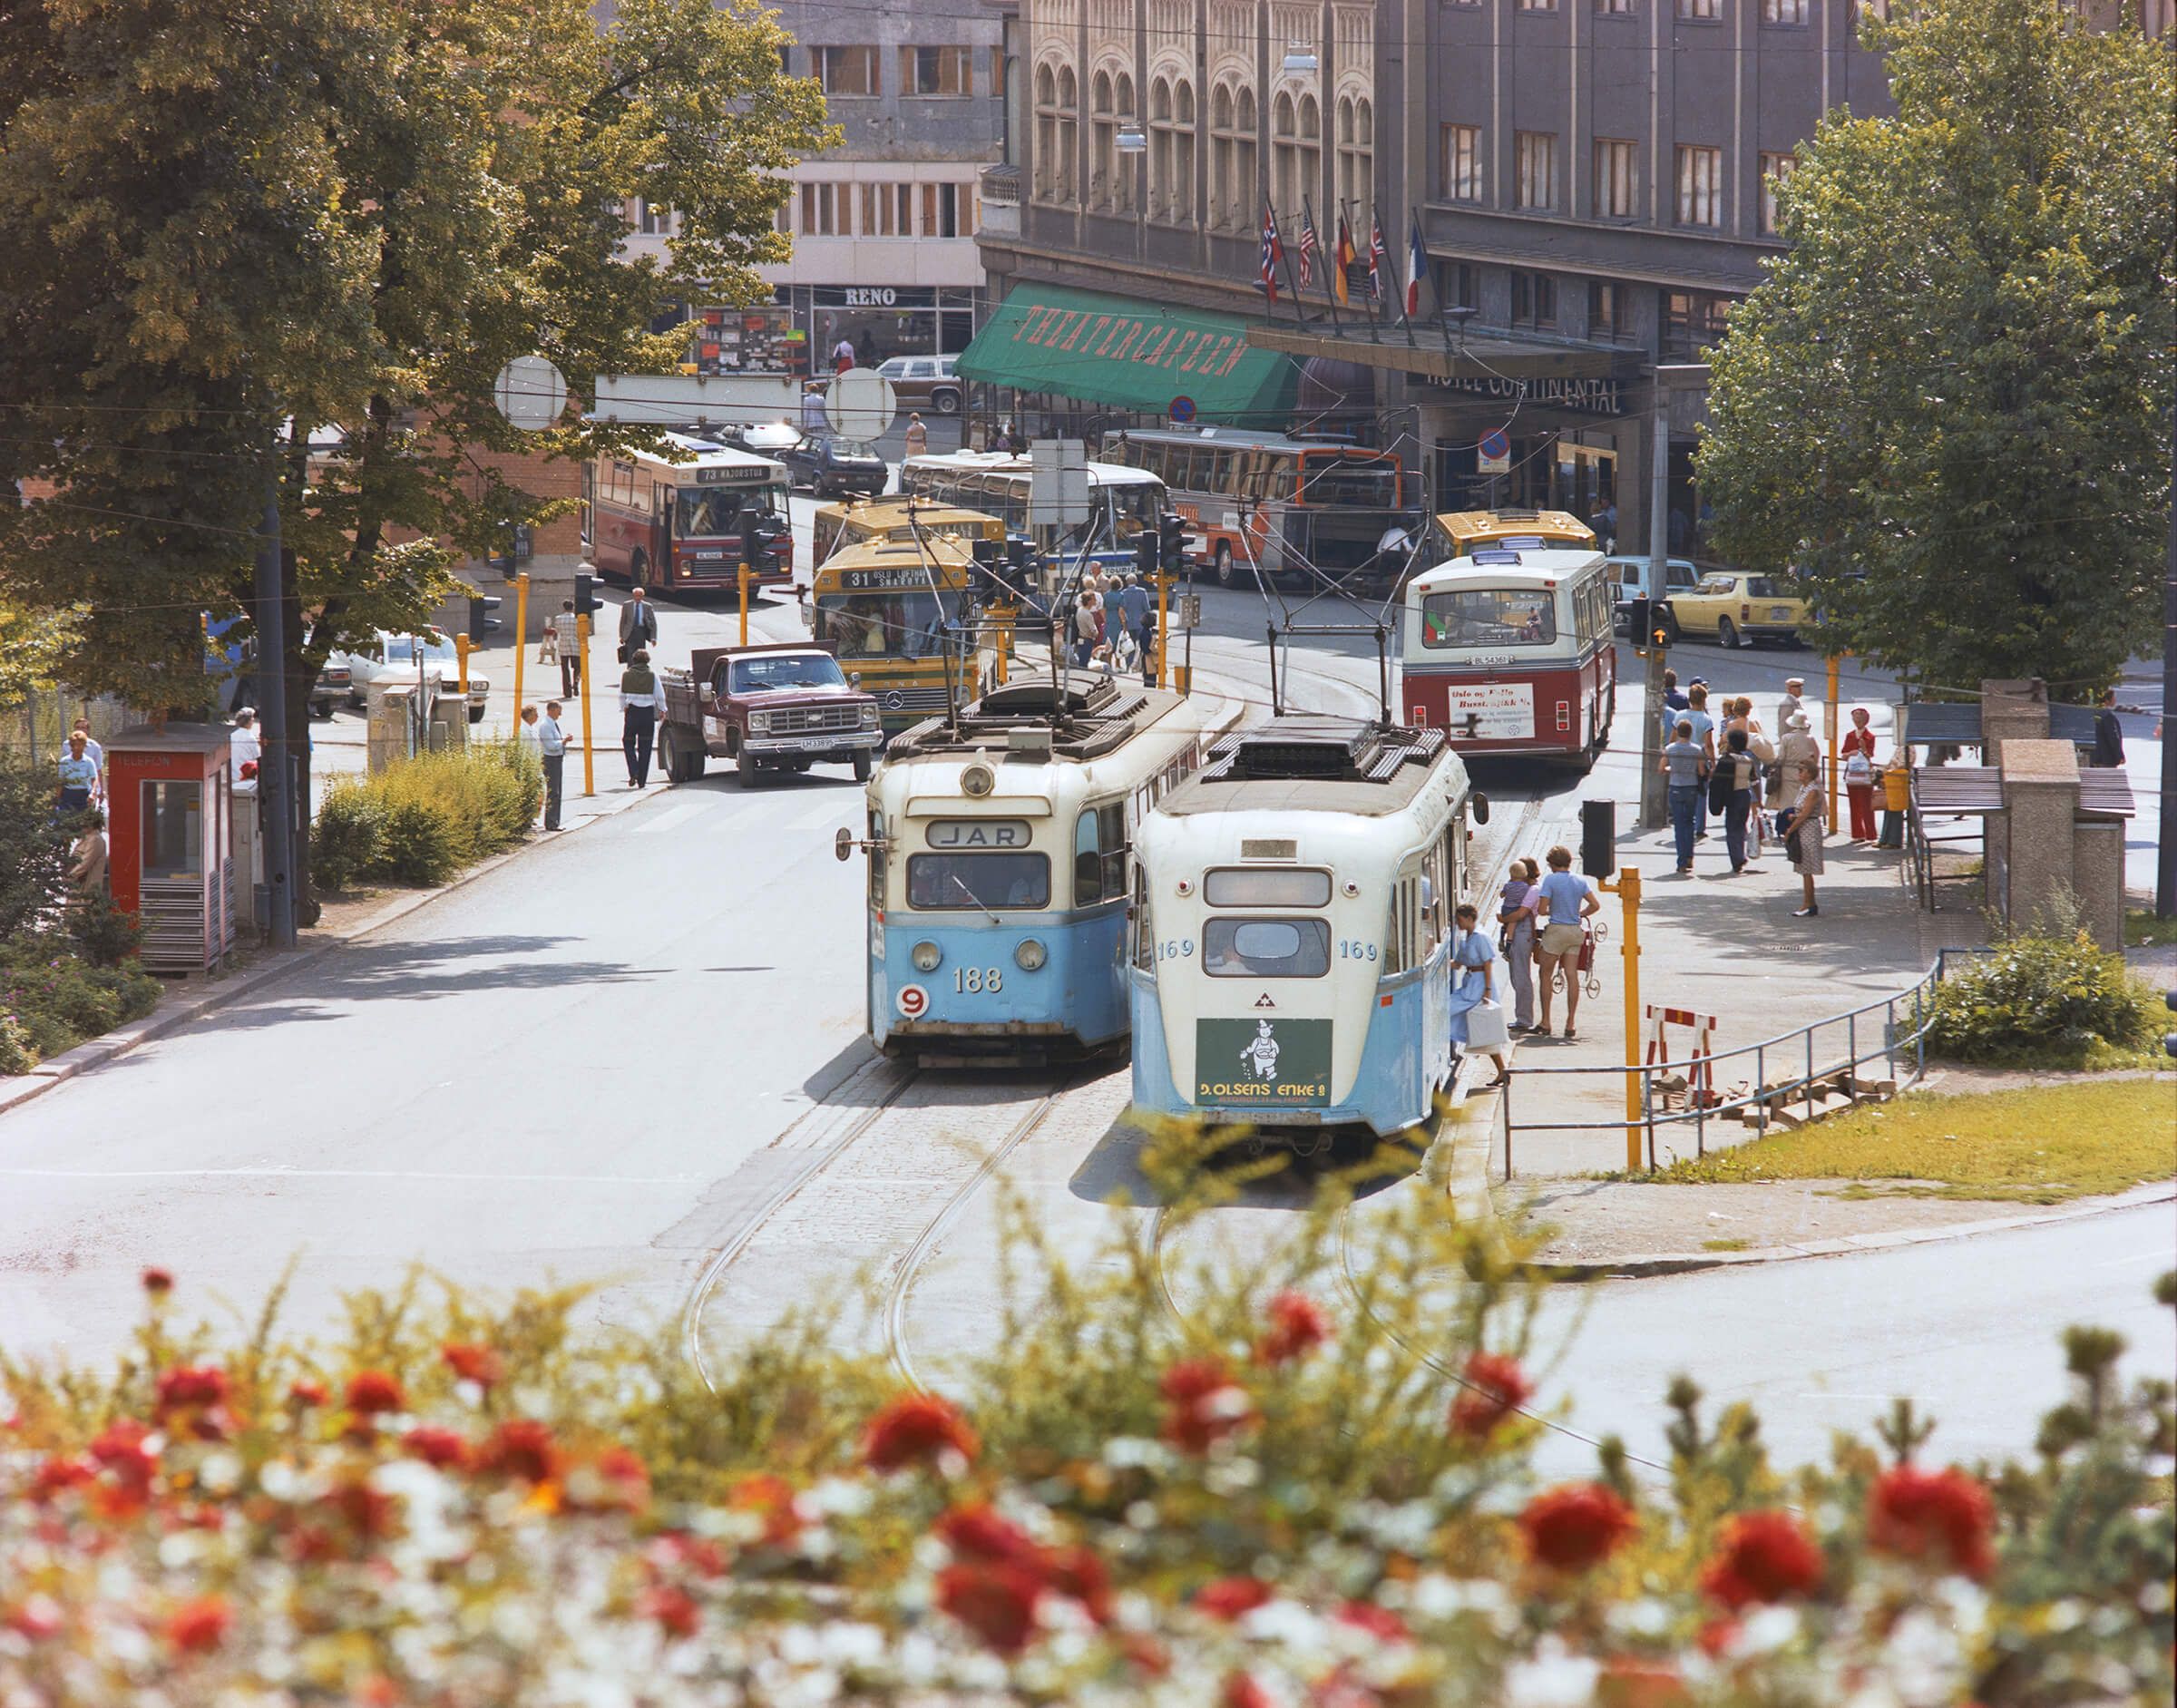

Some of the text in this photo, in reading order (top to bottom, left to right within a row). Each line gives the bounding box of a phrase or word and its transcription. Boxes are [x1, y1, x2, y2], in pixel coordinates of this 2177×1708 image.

[845, 288, 896, 306] RENO
[1012, 305, 1250, 377] THEATERCAFEEN
[1489, 376, 1621, 414] CONTINENTAL
[704, 469, 717, 480] 73
[851, 572, 869, 586] 31
[873, 568, 929, 580] OSLO LUFTHAV
[115, 754, 171, 767] TELEFON
[940, 826, 1016, 845] JAR
[1157, 939, 1195, 961] 169
[1339, 940, 1378, 961] 169
[953, 967, 1003, 993] 188
[902, 988, 924, 1013] 9
